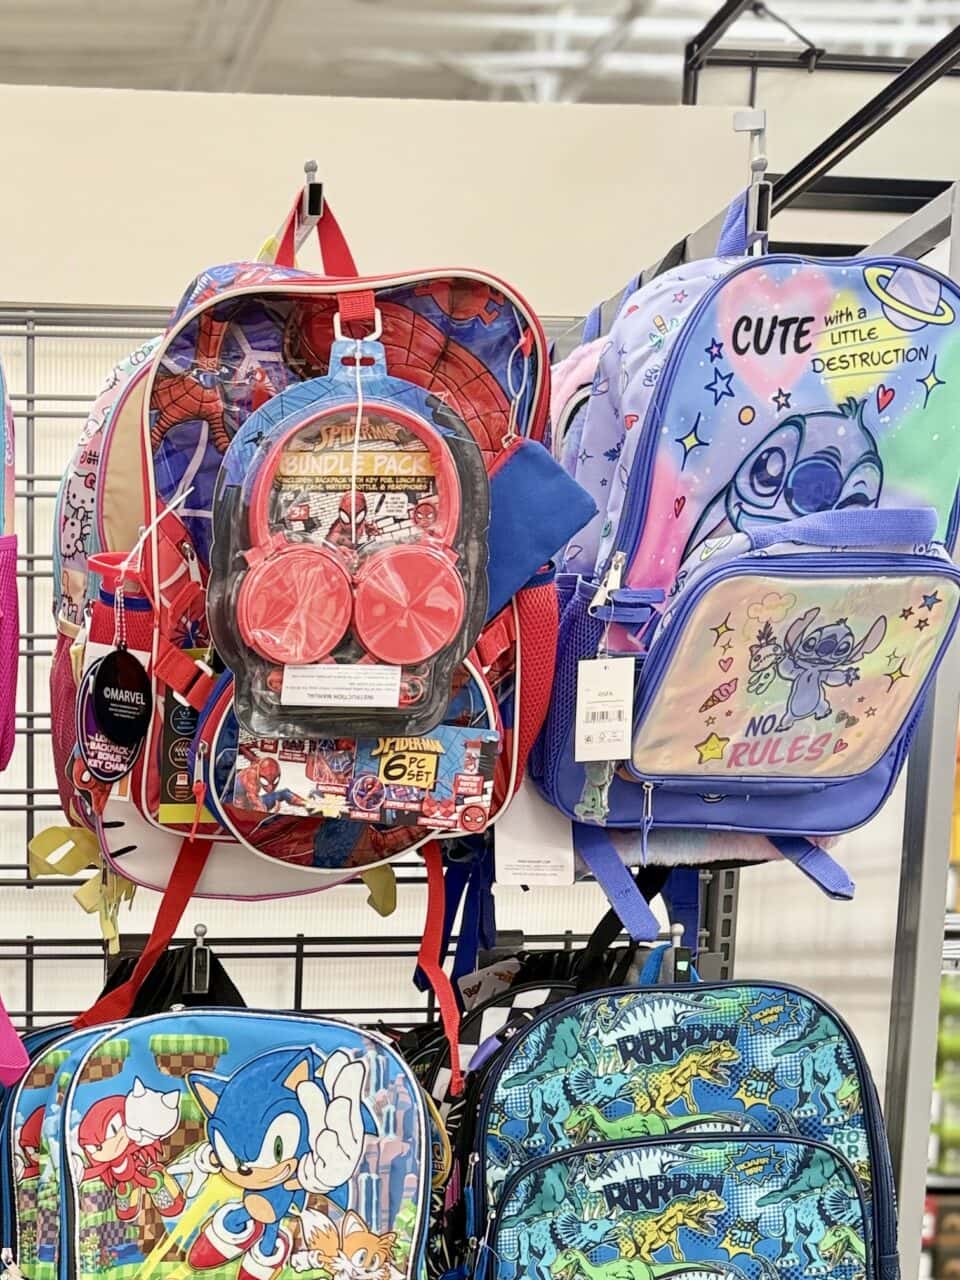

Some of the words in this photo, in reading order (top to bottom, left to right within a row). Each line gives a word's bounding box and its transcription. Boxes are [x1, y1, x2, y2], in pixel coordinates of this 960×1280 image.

[823, 309, 856, 327] with
[858, 308, 868, 321] a
[731, 315, 815, 356] CUTE
[830, 326, 879, 345] LITTLE
[811, 345, 930, 374] DESTRUCTION
[287, 454, 364, 475] BUNDLE
[374, 455, 425, 475] PACK
[727, 732, 834, 769] RULES
[383, 754, 408, 781] 6
[408, 757, 427, 769] PC
[407, 769, 433, 782] SET
